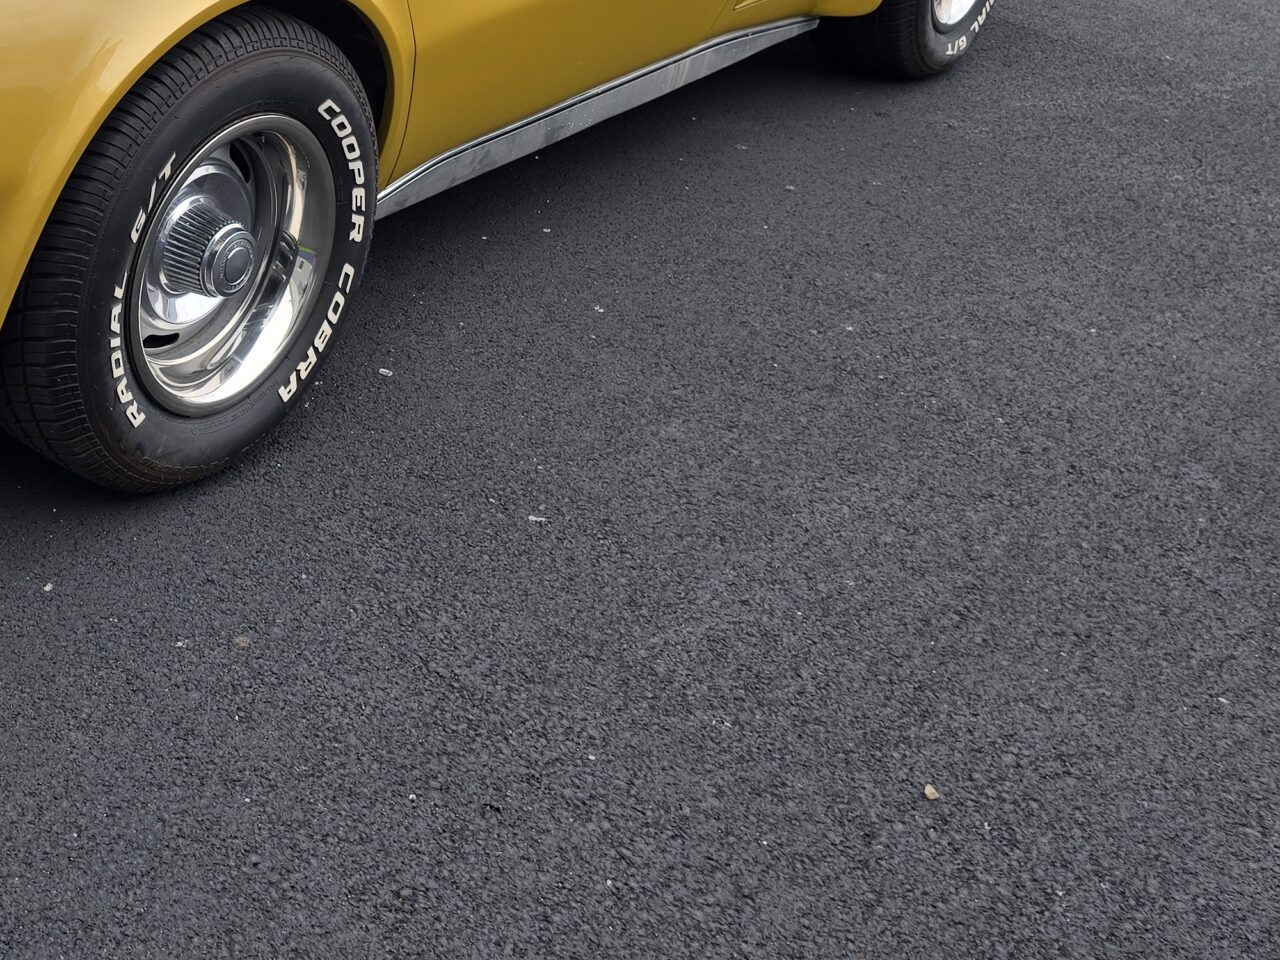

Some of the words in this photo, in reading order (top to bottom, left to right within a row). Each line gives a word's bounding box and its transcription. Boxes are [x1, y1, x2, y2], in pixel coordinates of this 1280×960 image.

[946, 35, 966, 55] G/T
[318, 98, 366, 243] COOPER
[110, 268, 146, 428] RADIAL
[131, 152, 176, 244] G/T
[278, 262, 355, 403] COBRA
